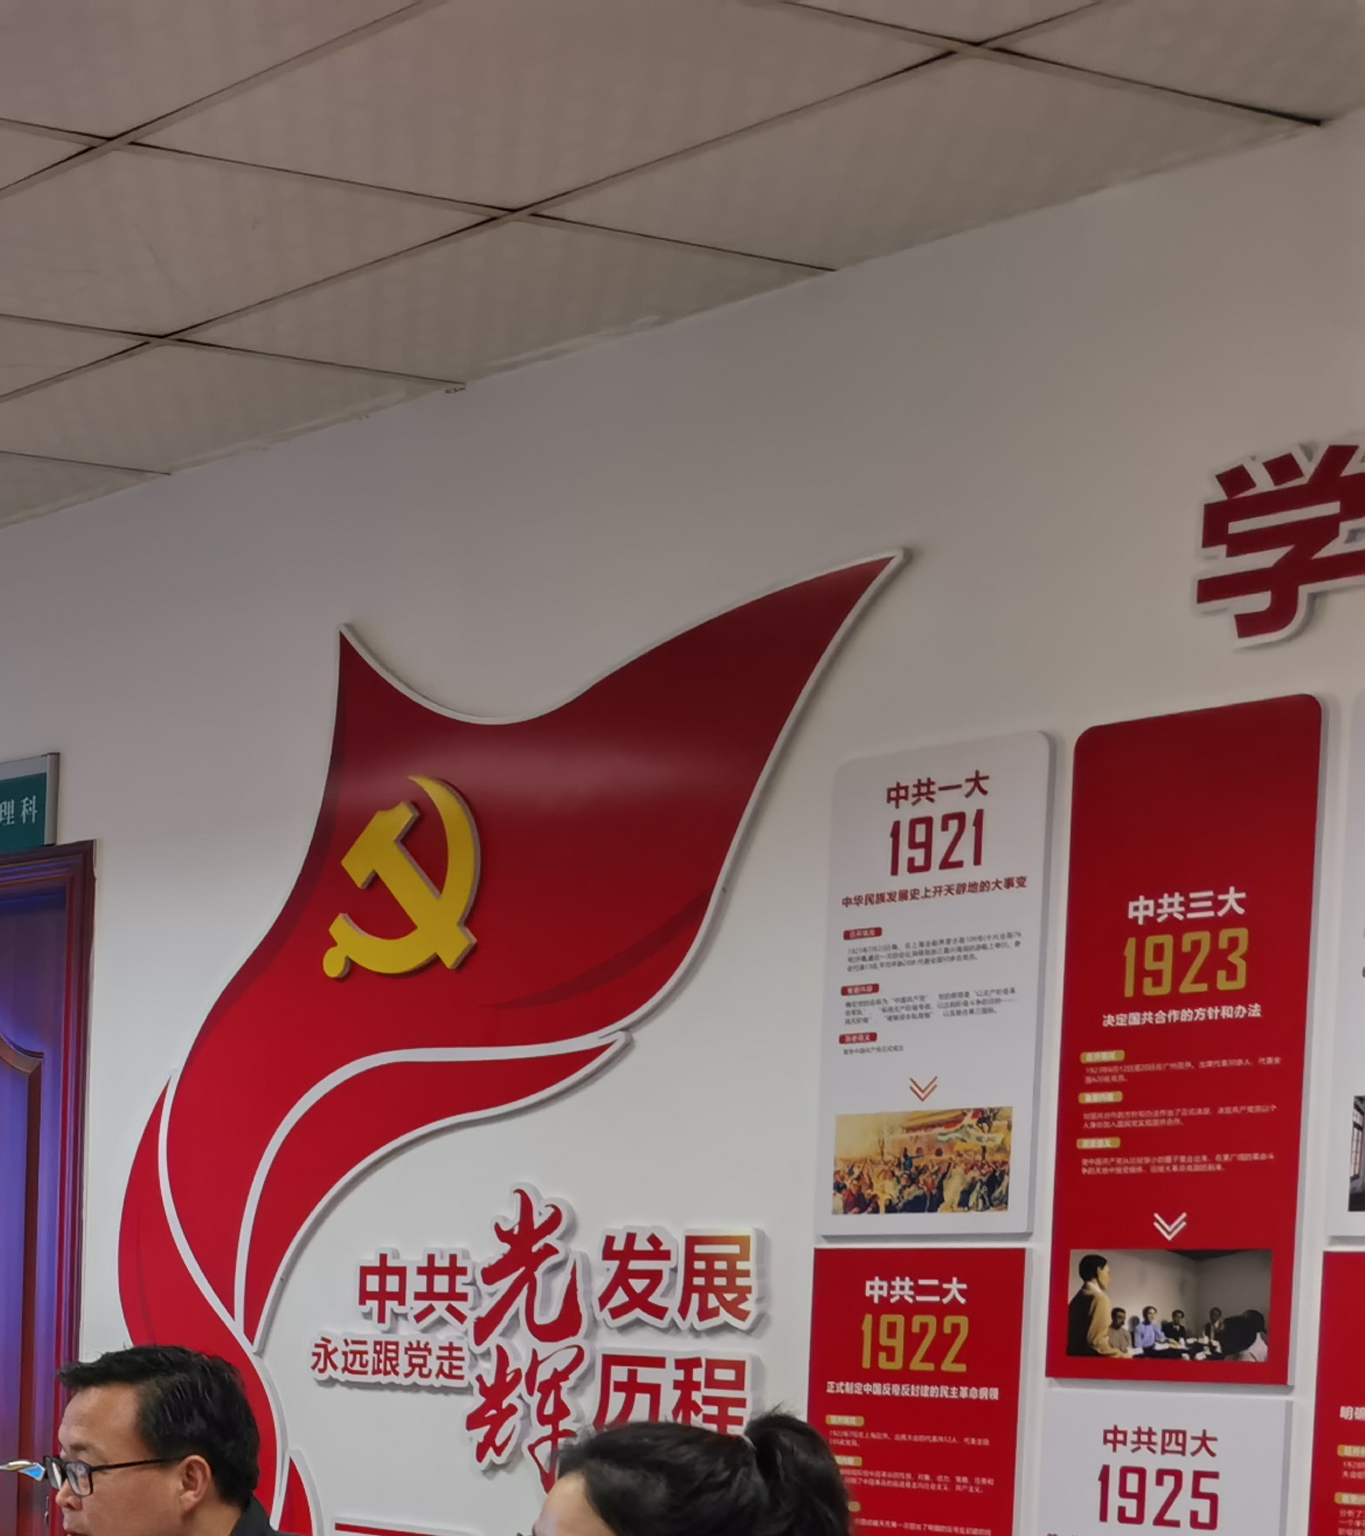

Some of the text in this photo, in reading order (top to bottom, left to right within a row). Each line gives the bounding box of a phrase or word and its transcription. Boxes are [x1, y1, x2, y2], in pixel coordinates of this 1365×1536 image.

[1195, 444, 1365, 639] 学
[886, 769, 990, 809] 中共一大
[889, 808, 985, 877] 1921
[841, 875, 1028, 908] 中华民族发展史上开天辟地的大事变
[1127, 886, 1247, 926] 中共三大
[1123, 927, 1250, 998] 1923
[1102, 1002, 1263, 1028] 决定国共合作的方针和办法
[357, 1252, 469, 1327] 中共
[597, 1231, 754, 1324] 发展
[864, 1275, 968, 1304] 中共二大
[310, 1336, 467, 1382] 永远跟党走
[861, 1313, 969, 1373] 1922
[592, 1352, 749, 1435] 历程
[1102, 1424, 1219, 1458] 中共四大
[1097, 1464, 1221, 1531] 1925
